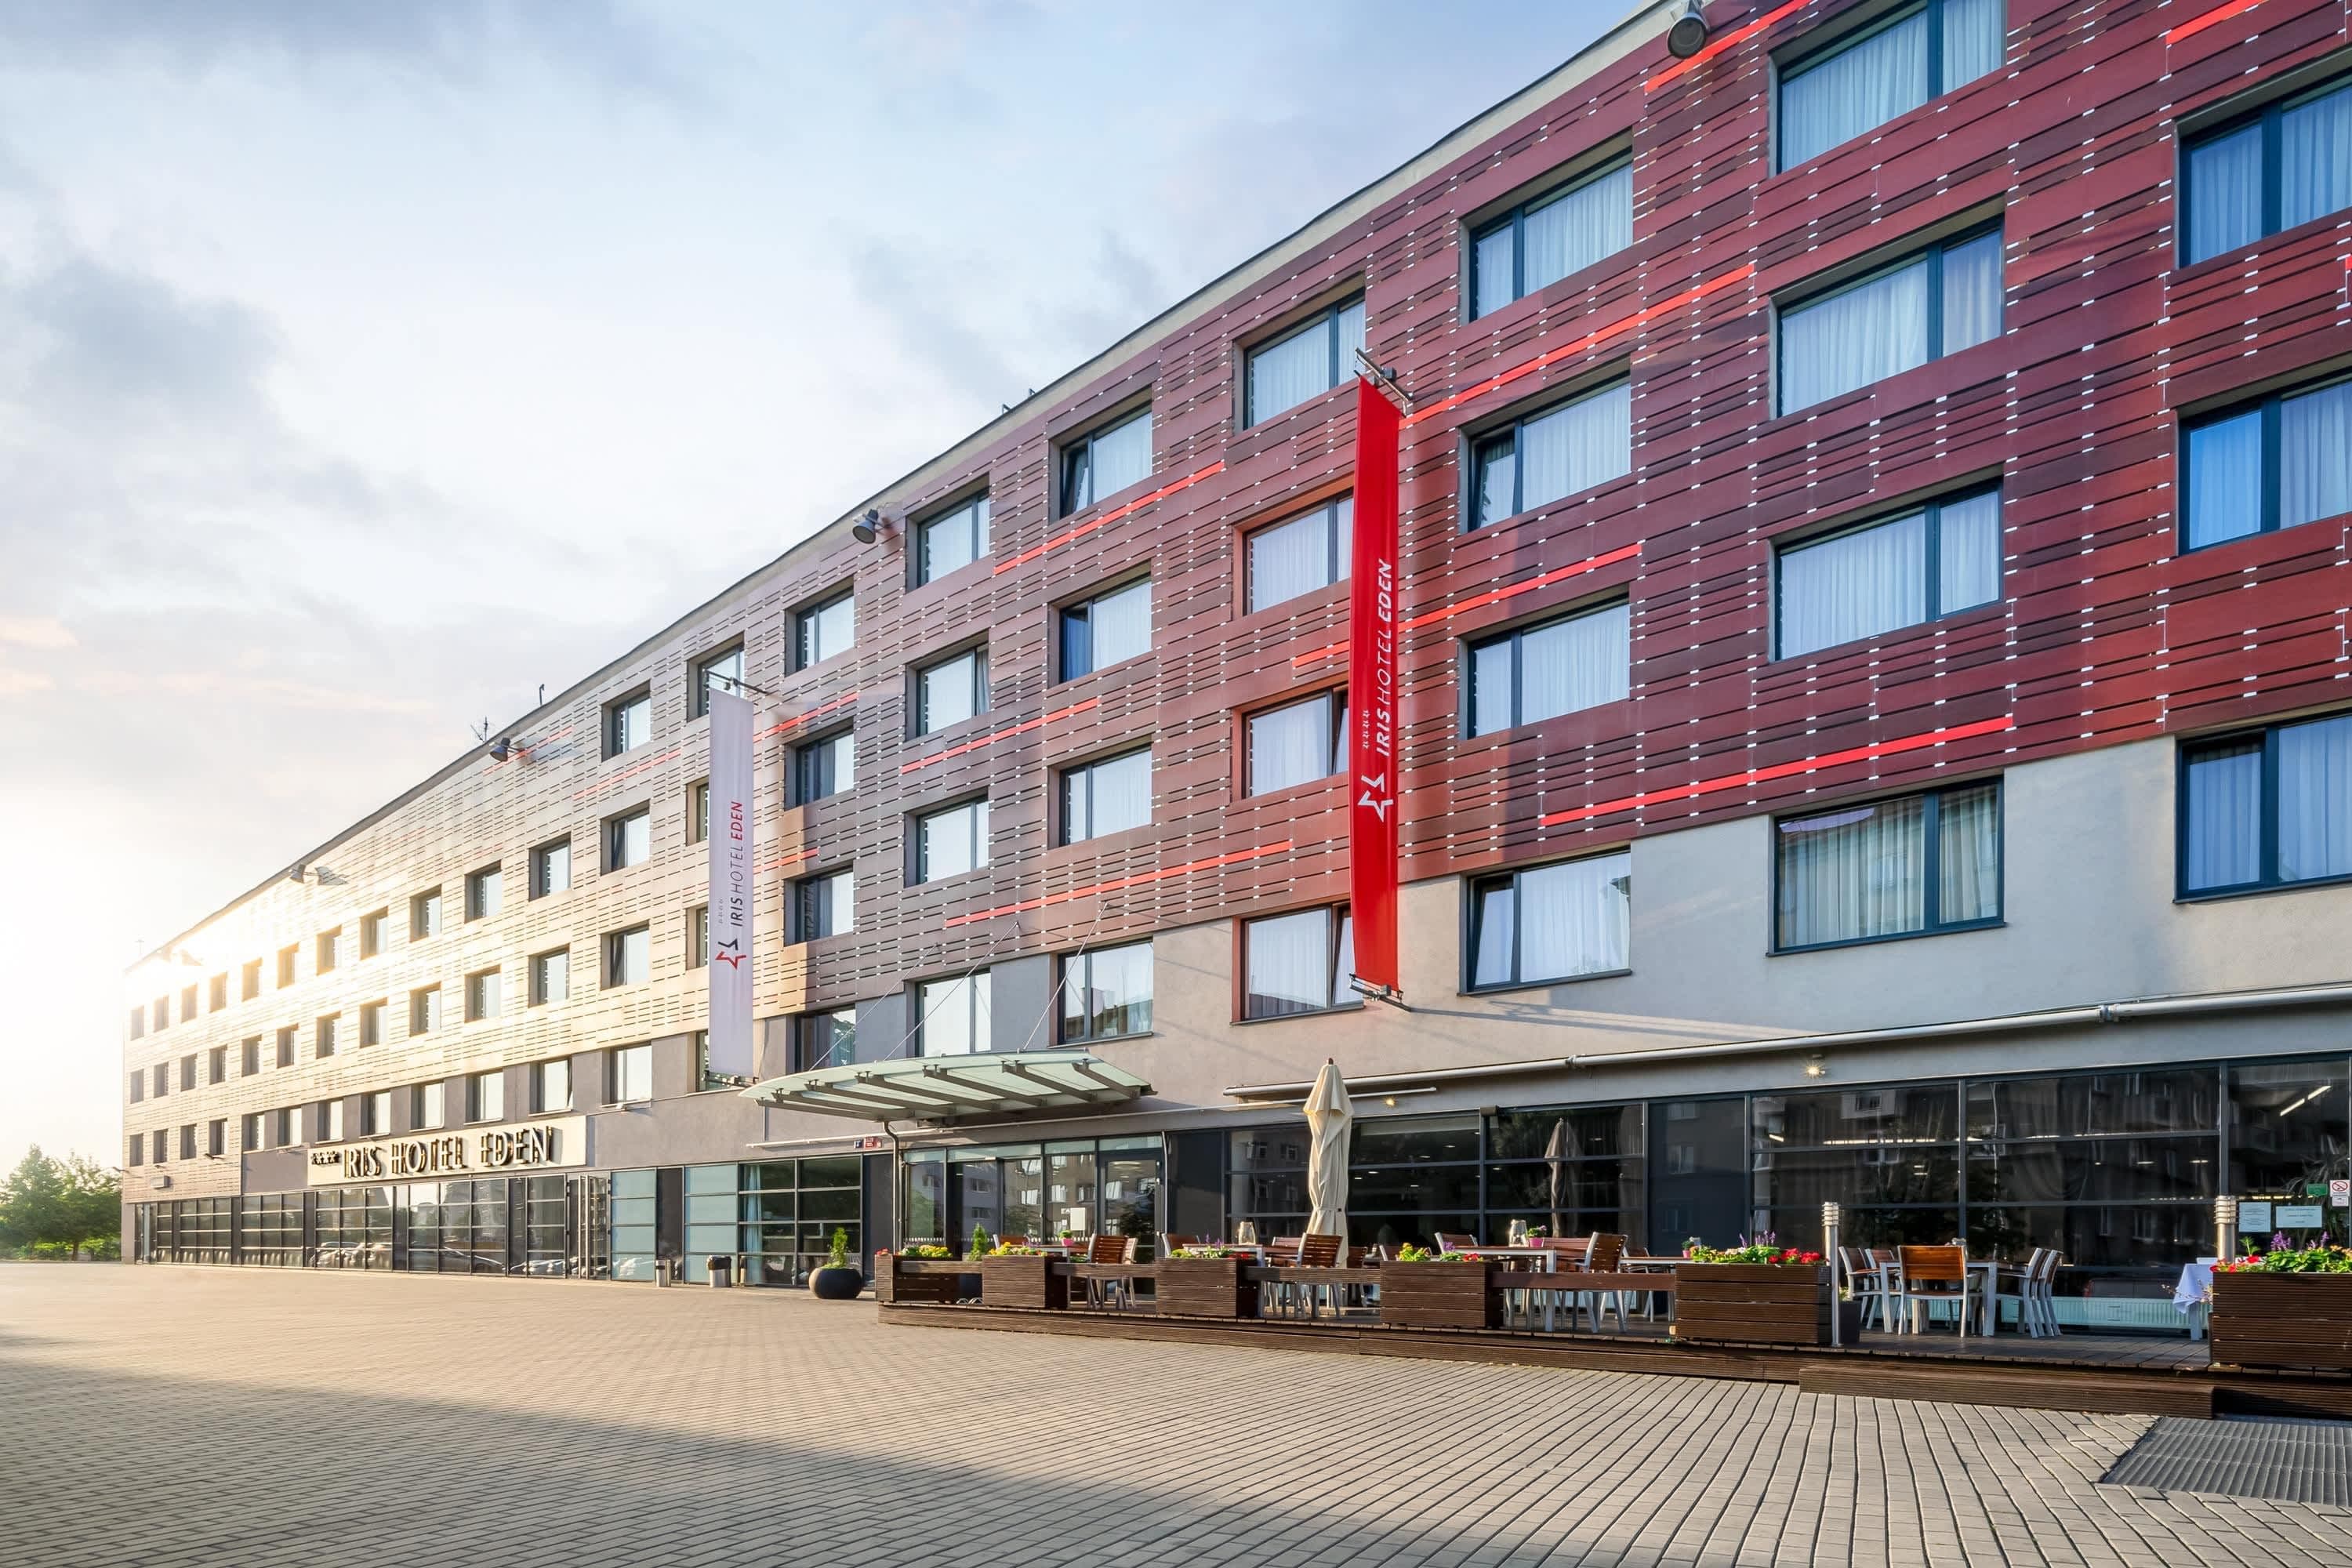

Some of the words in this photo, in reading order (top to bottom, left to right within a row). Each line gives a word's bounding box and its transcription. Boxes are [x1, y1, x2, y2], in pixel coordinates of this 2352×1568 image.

[1377, 558, 1392, 622] EDEN
[1377, 630, 1392, 706] HOTEL
[1376, 708, 1391, 757] IRIS
[730, 801, 743, 841] EDEN
[730, 846, 743, 895] HOTEL
[730, 897, 743, 927] IRIS
[340, 1146, 382, 1178] IRIS
[389, 1136, 468, 1174] HOTEL
[479, 1125, 552, 1167] EDEN
